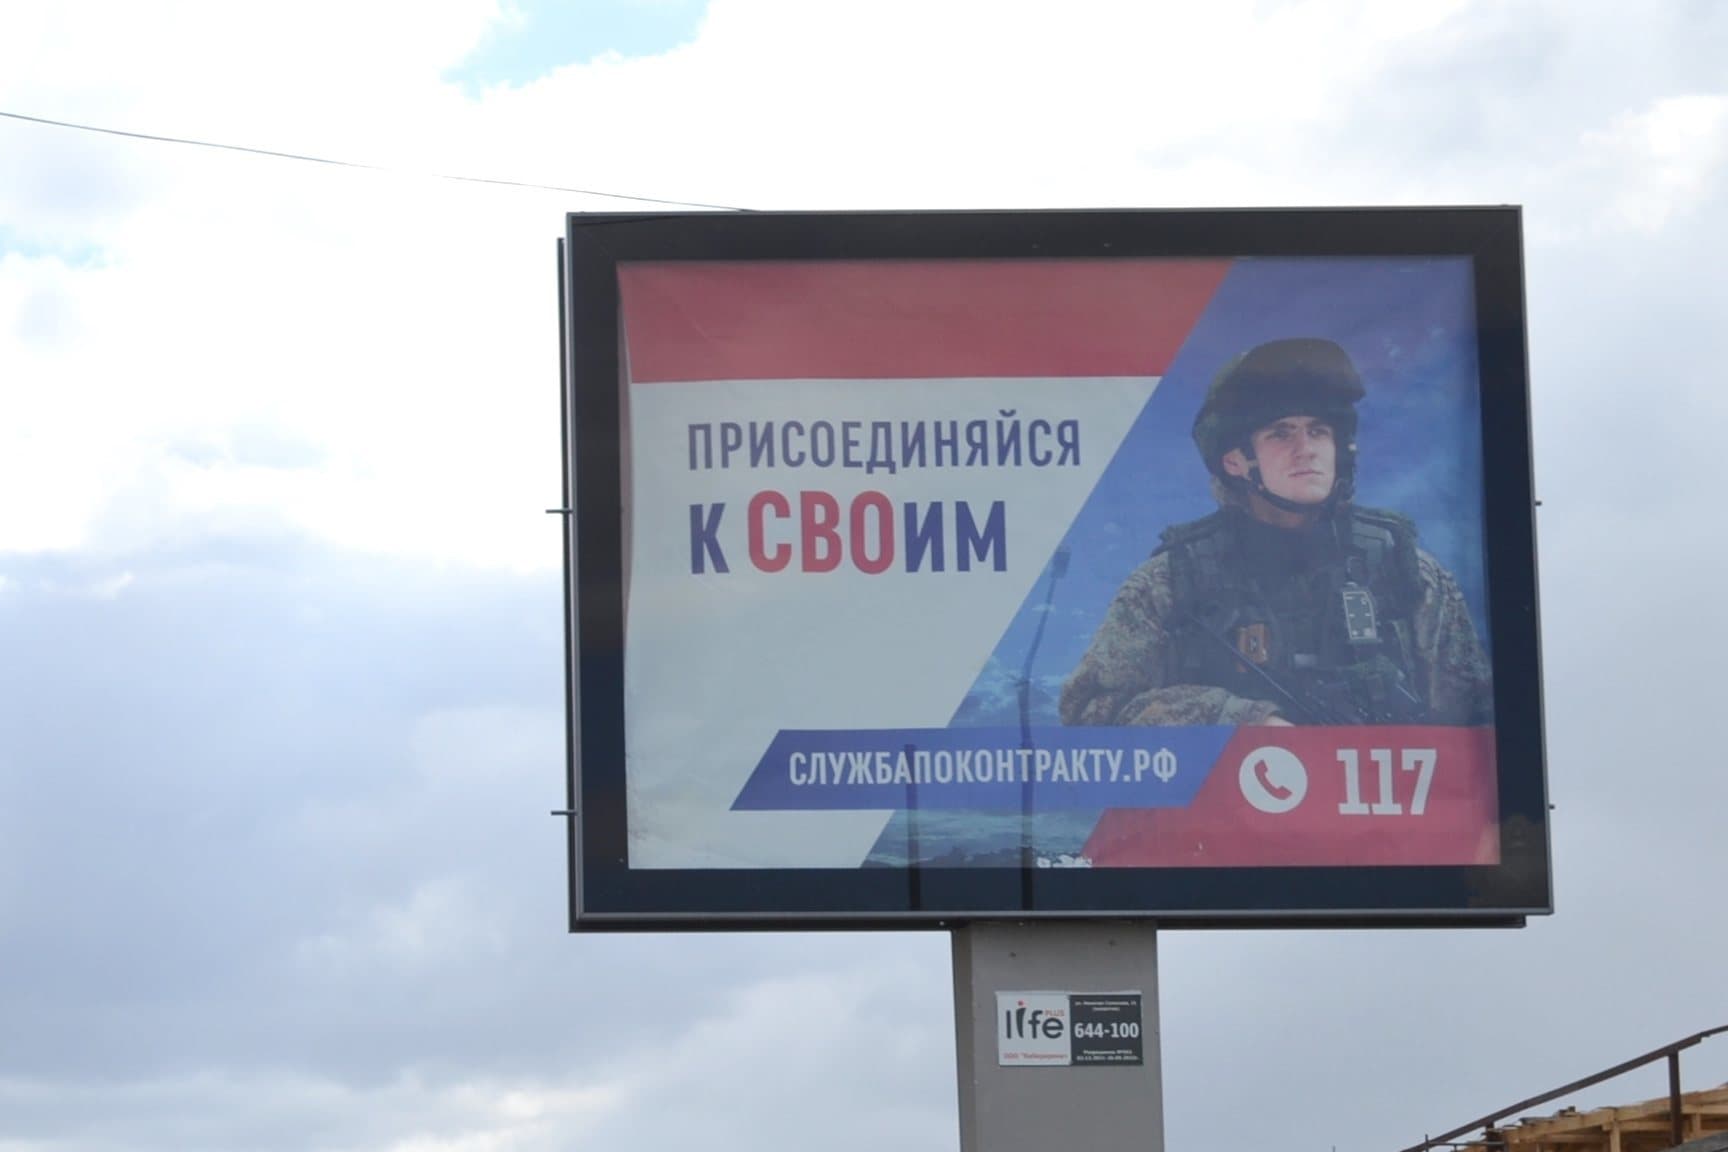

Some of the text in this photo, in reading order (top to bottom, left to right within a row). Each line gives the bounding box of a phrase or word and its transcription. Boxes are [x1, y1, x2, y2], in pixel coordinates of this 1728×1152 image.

[687, 408, 1081, 475] ПРИСОЕДИНЯЙСЯ
[688, 489, 1008, 575] К СВОИМ
[788, 747, 1178, 787] СЛУЖБАПОКОНТРАКТУ.РФ
[1335, 748, 1438, 816] 117
[1074, 1022, 1140, 1039] 644-100
